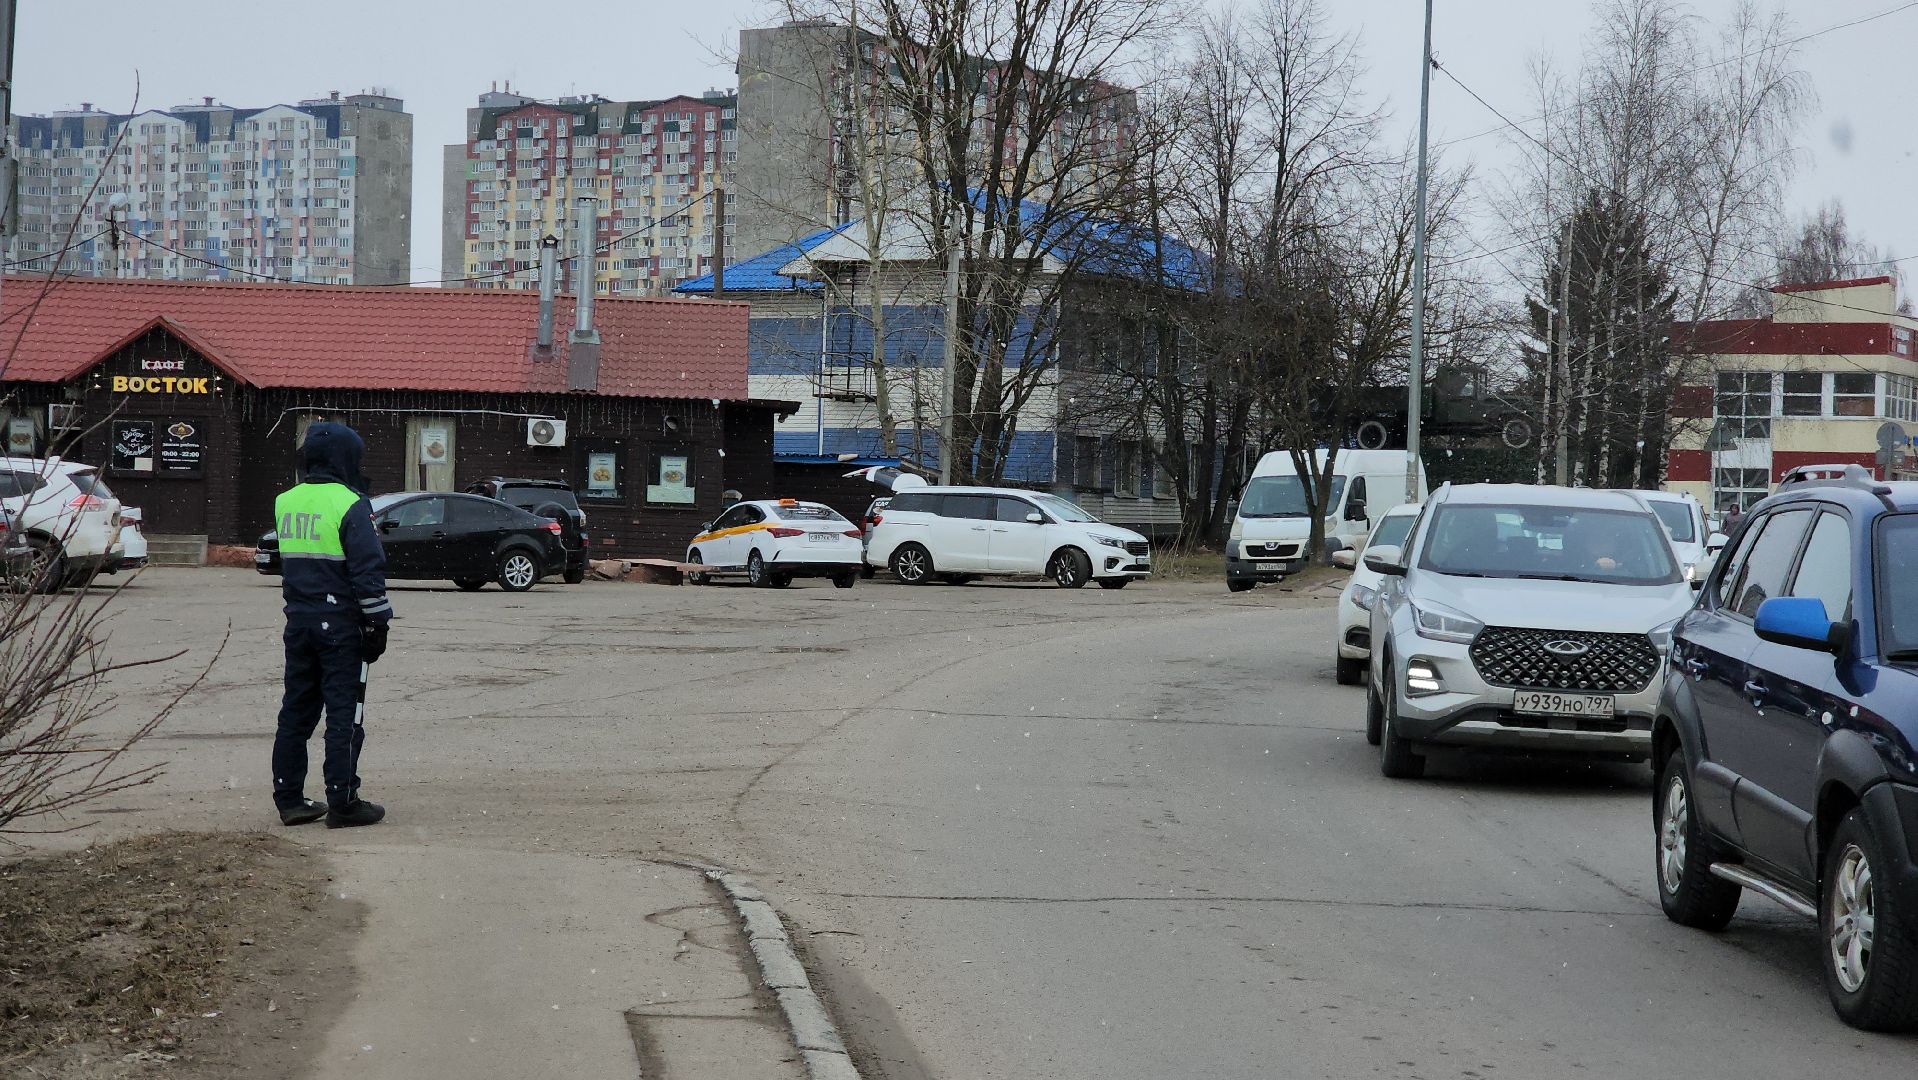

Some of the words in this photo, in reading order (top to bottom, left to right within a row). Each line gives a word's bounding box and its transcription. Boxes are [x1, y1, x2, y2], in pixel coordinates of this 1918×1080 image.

[141, 359, 185, 370] КАФЕ
[113, 376, 208, 394] ВОСТОК
[280, 512, 322, 540] ДПС
